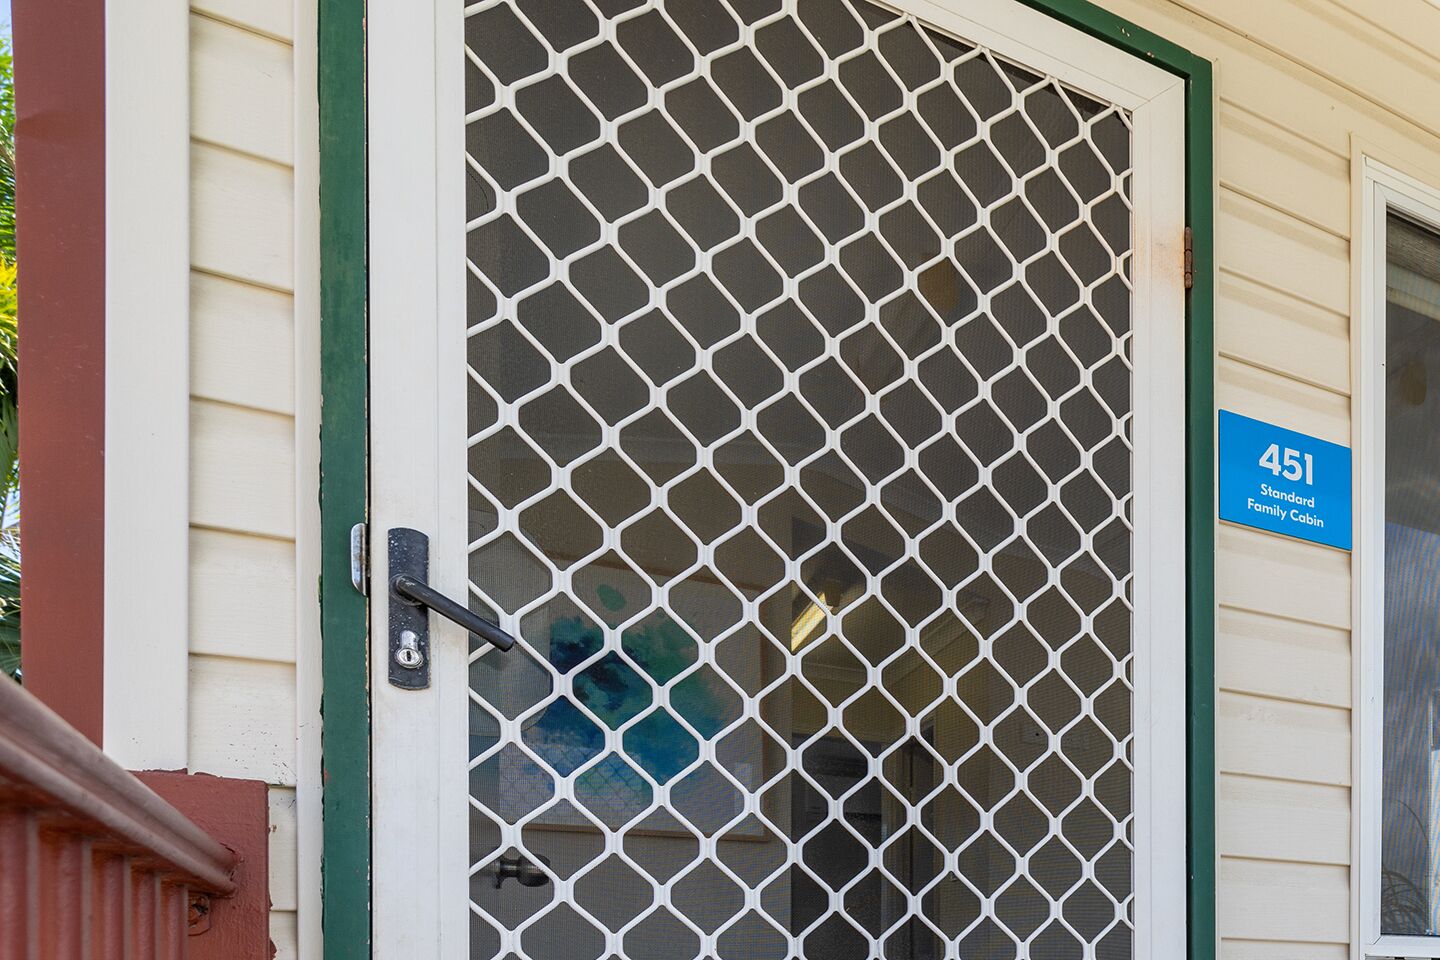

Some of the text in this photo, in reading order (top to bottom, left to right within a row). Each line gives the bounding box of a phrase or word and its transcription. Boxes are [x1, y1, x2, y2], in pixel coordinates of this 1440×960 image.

[1258, 443, 1313, 486] 451
[1260, 483, 1315, 508] Standard
[1247, 498, 1324, 528] Family Cabin
